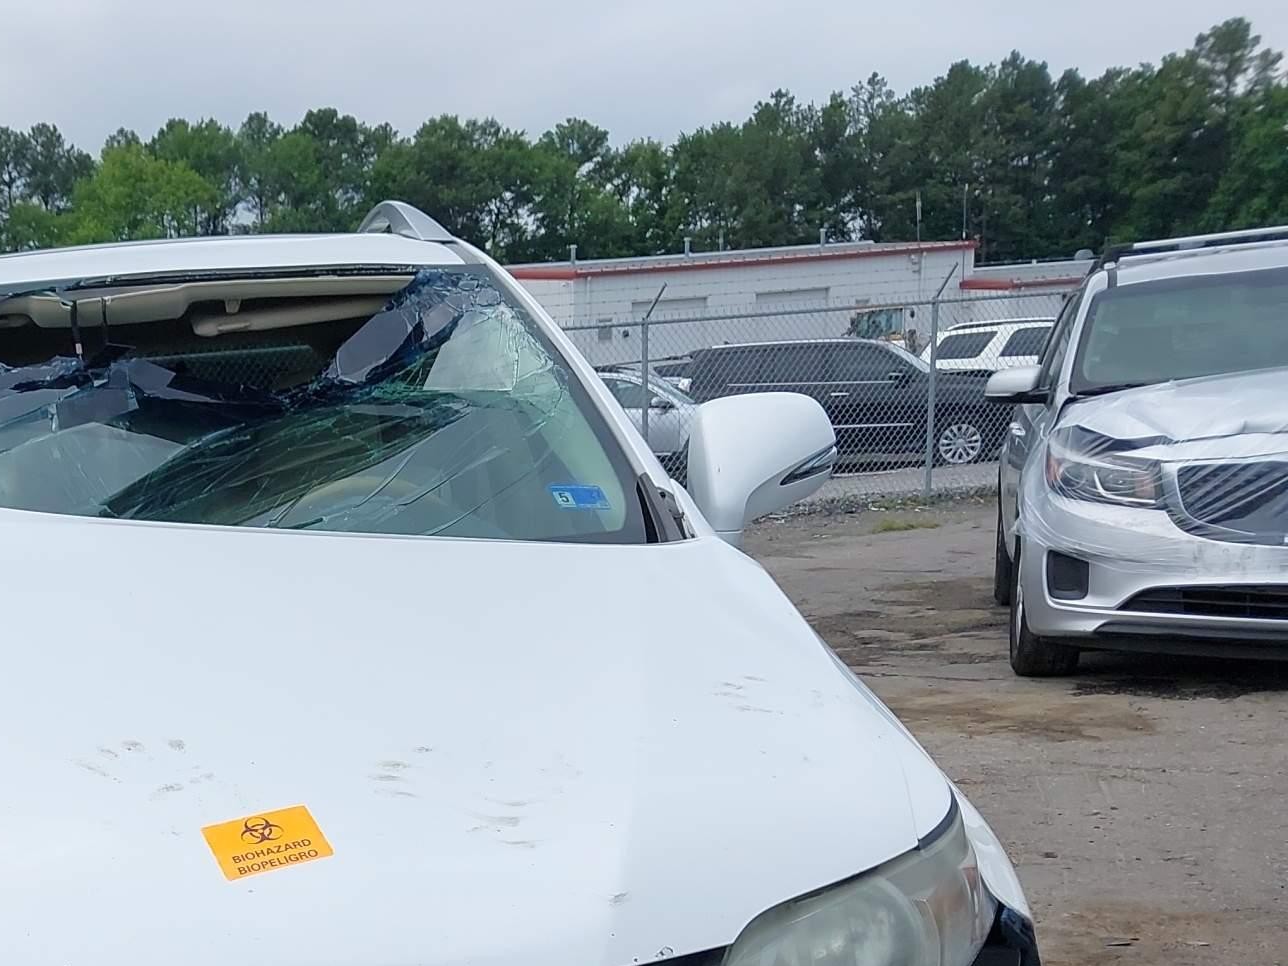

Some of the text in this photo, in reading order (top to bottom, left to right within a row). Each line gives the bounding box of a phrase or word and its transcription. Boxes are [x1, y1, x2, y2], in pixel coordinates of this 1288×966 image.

[558, 492, 570, 503] 5
[232, 839, 312, 864] BIOHAZARD
[238, 849, 318, 875] BIOPELIGRO
